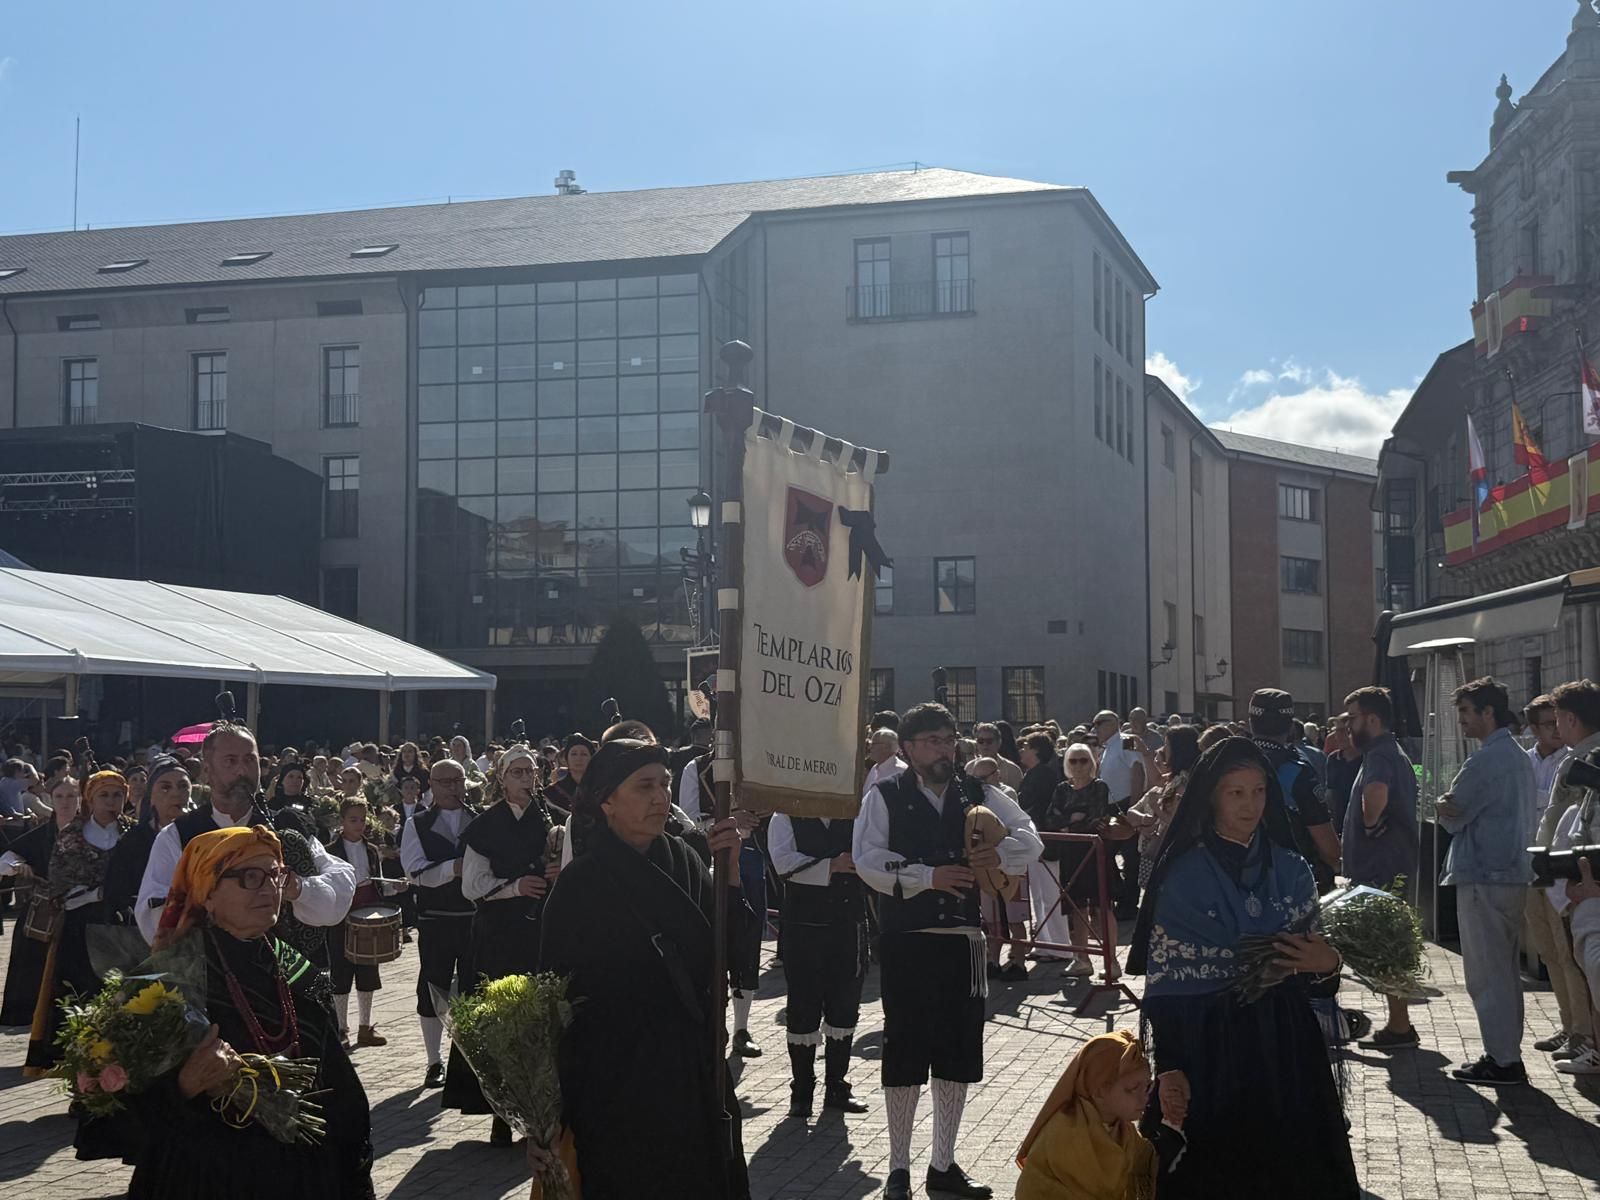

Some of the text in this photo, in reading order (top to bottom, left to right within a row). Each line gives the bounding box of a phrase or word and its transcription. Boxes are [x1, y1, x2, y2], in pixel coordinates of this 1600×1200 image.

[753, 623, 853, 675] TEMPLARIOS
[761, 669, 843, 707] DEL OZA
[787, 756, 801, 771] DE
